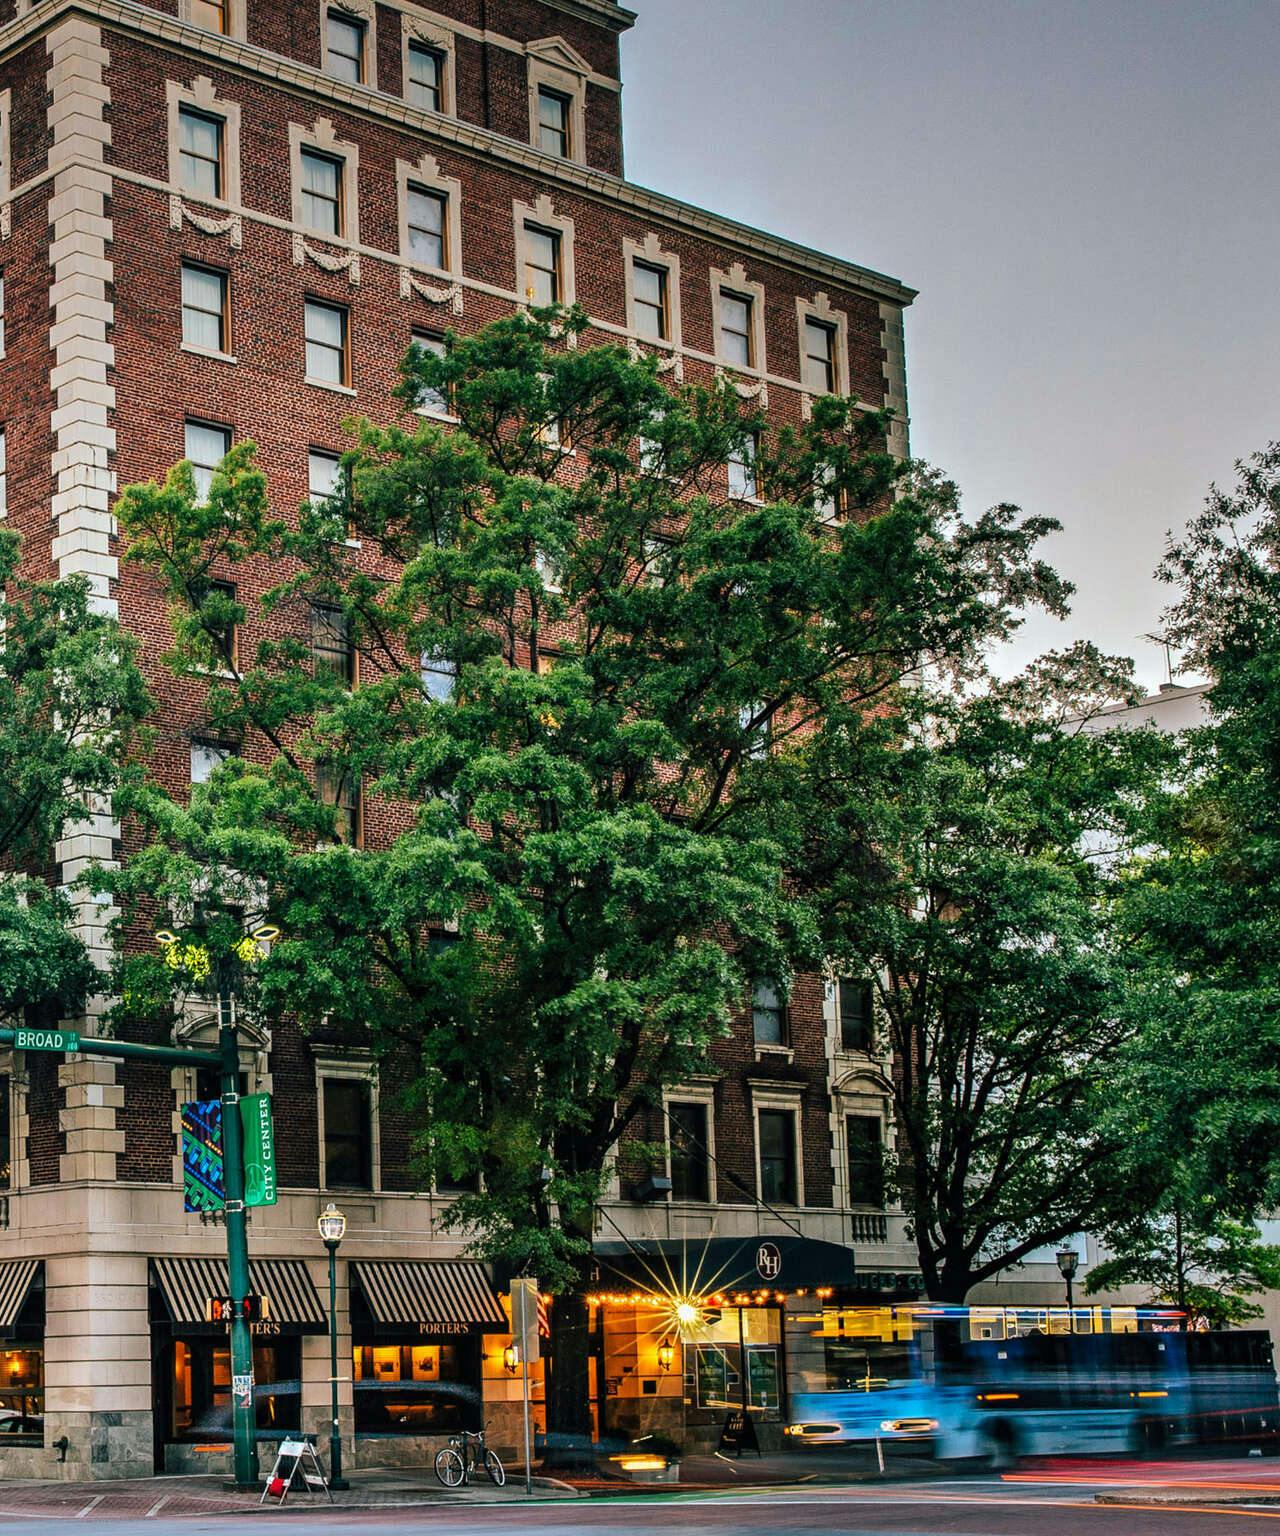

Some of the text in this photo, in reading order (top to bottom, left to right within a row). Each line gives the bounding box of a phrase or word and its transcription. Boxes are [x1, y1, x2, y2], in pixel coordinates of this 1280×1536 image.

[18, 1031, 63, 1048] BROAD
[259, 1098, 274, 1200] CITY CENTER
[225, 1322, 281, 1334] PTER'S
[420, 1322, 469, 1334] PORTER'S
